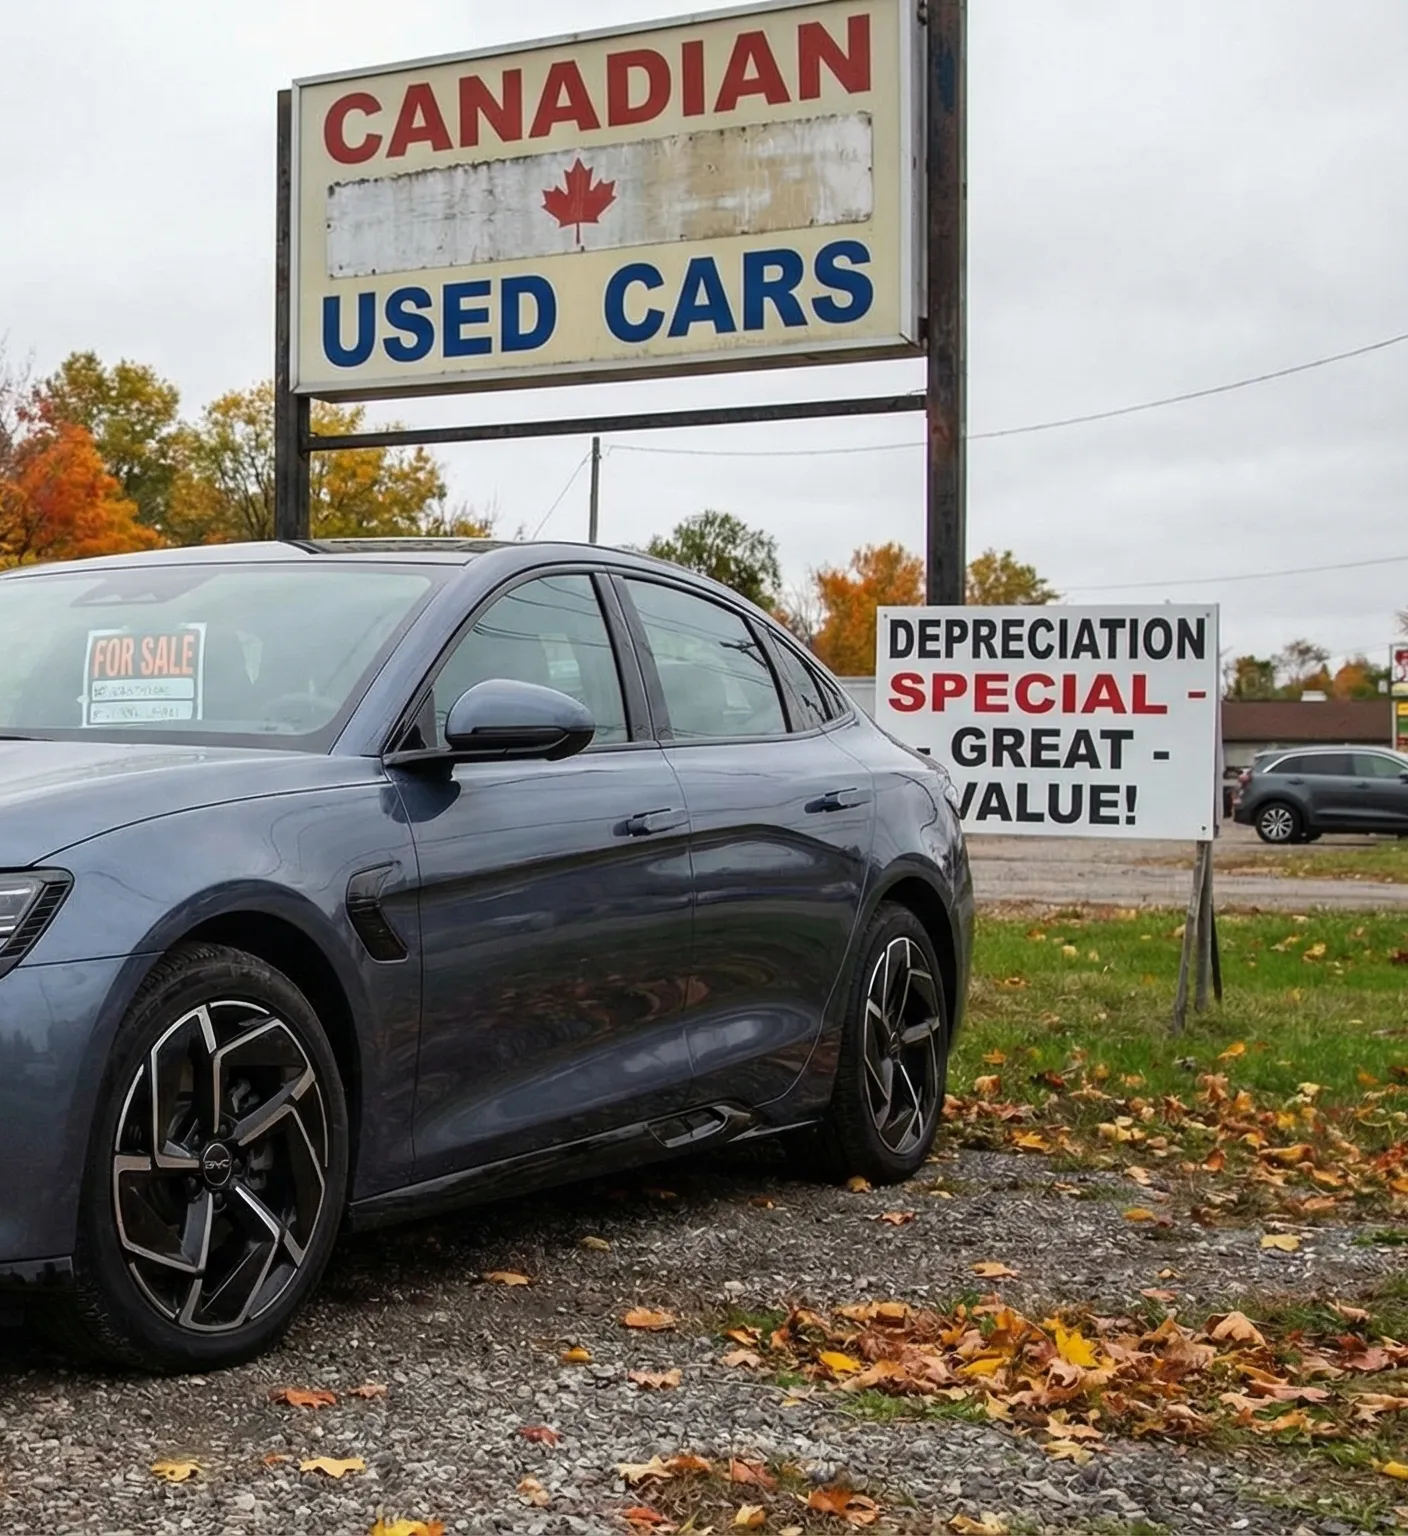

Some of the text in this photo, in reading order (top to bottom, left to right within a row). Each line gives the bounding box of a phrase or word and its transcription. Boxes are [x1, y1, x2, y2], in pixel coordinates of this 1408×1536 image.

[324, 14, 871, 164] CANADIAN
[323, 239, 874, 367] USED CARS
[94, 634, 196, 679] FOR SALE
[889, 617, 1206, 660] DEPRECIATION
[888, 672, 1168, 715] SPECIAL
[951, 726, 1134, 770] GREAT
